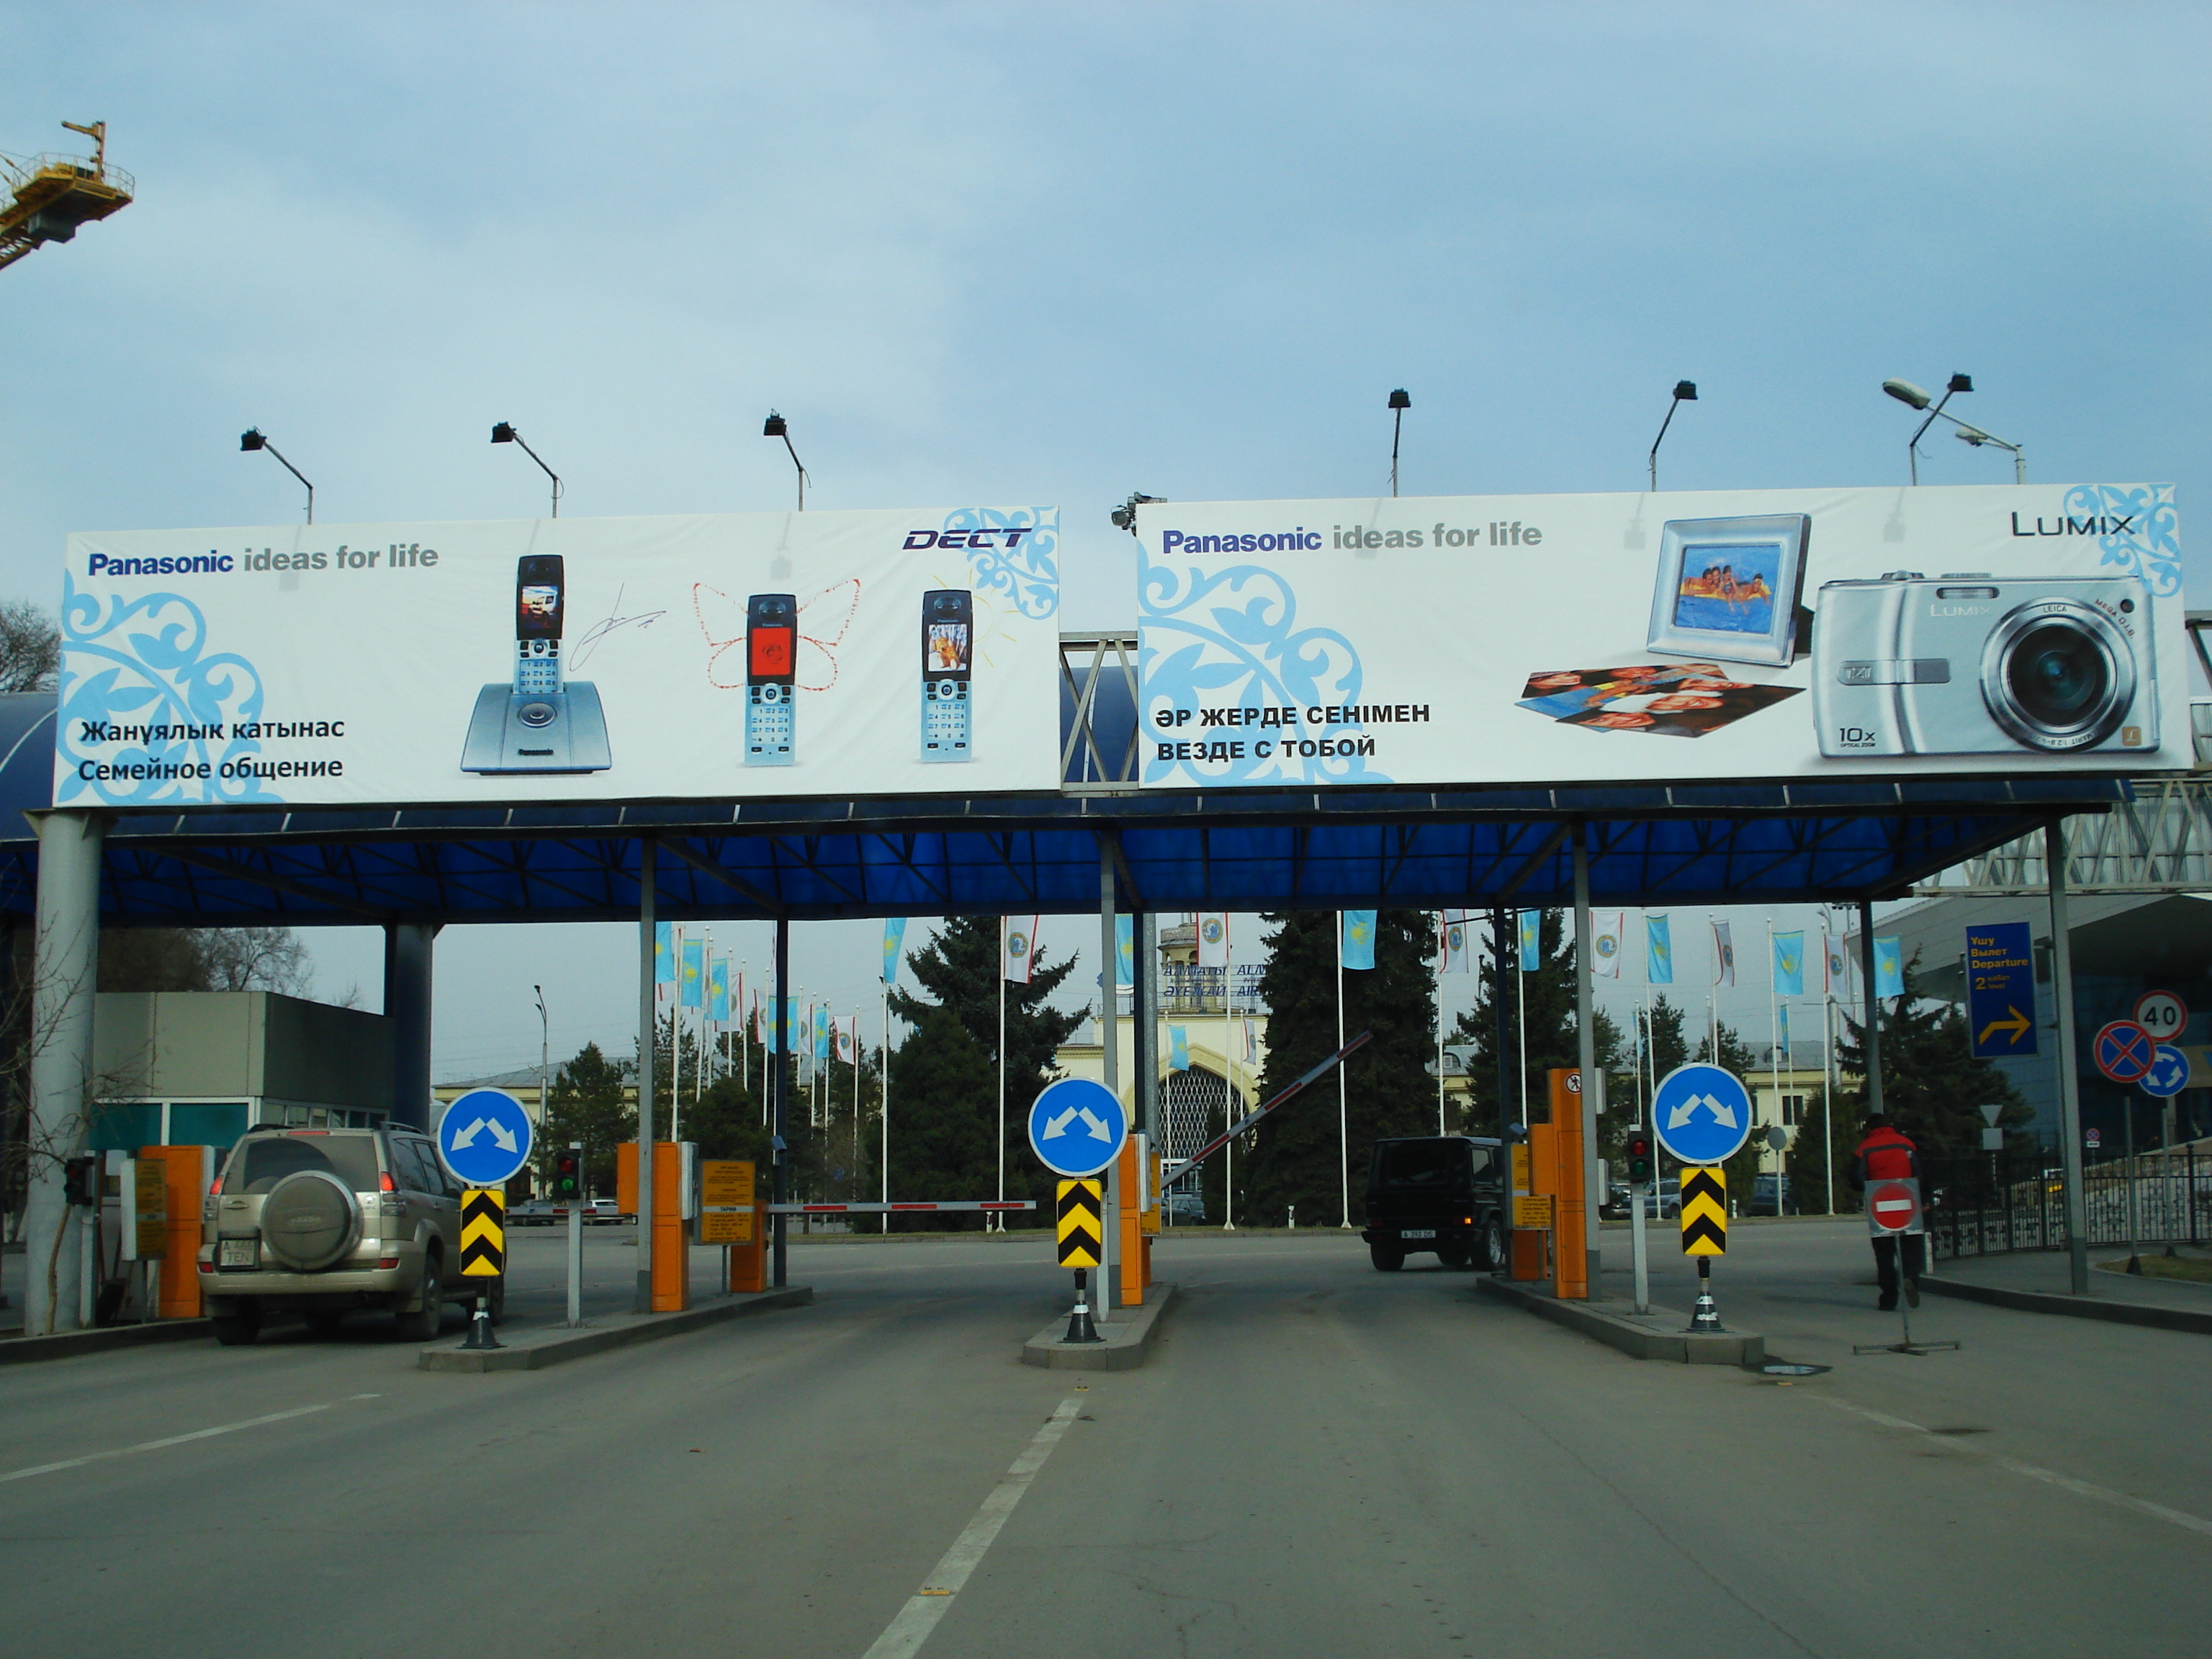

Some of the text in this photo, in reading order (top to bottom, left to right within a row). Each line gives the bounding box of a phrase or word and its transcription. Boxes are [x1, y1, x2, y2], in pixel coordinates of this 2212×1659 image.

[2012, 511, 2136, 536] LUMIX
[902, 528, 1033, 550] DECT
[1163, 521, 1543, 554] Panasonic ideas for life
[88, 542, 439, 576] Panasonic ideas for life
[1930, 604, 1991, 617] LUMIX
[2095, 598, 2118, 617] MEGA
[1156, 704, 1430, 729] ӘР ЖЕРДЕ СЕНІМЕН
[233, 721, 345, 740] қатынас
[1839, 728, 1876, 742] 10x
[1157, 734, 1376, 763] ВЕЗДЕ С ТОБОЙ
[78, 757, 343, 781] Семейное общение
[1971, 948, 2008, 958] Вылет
[1972, 958, 2028, 970] Departure
[1975, 976, 1986, 990] 2
[2144, 1006, 2177, 1026] 40
